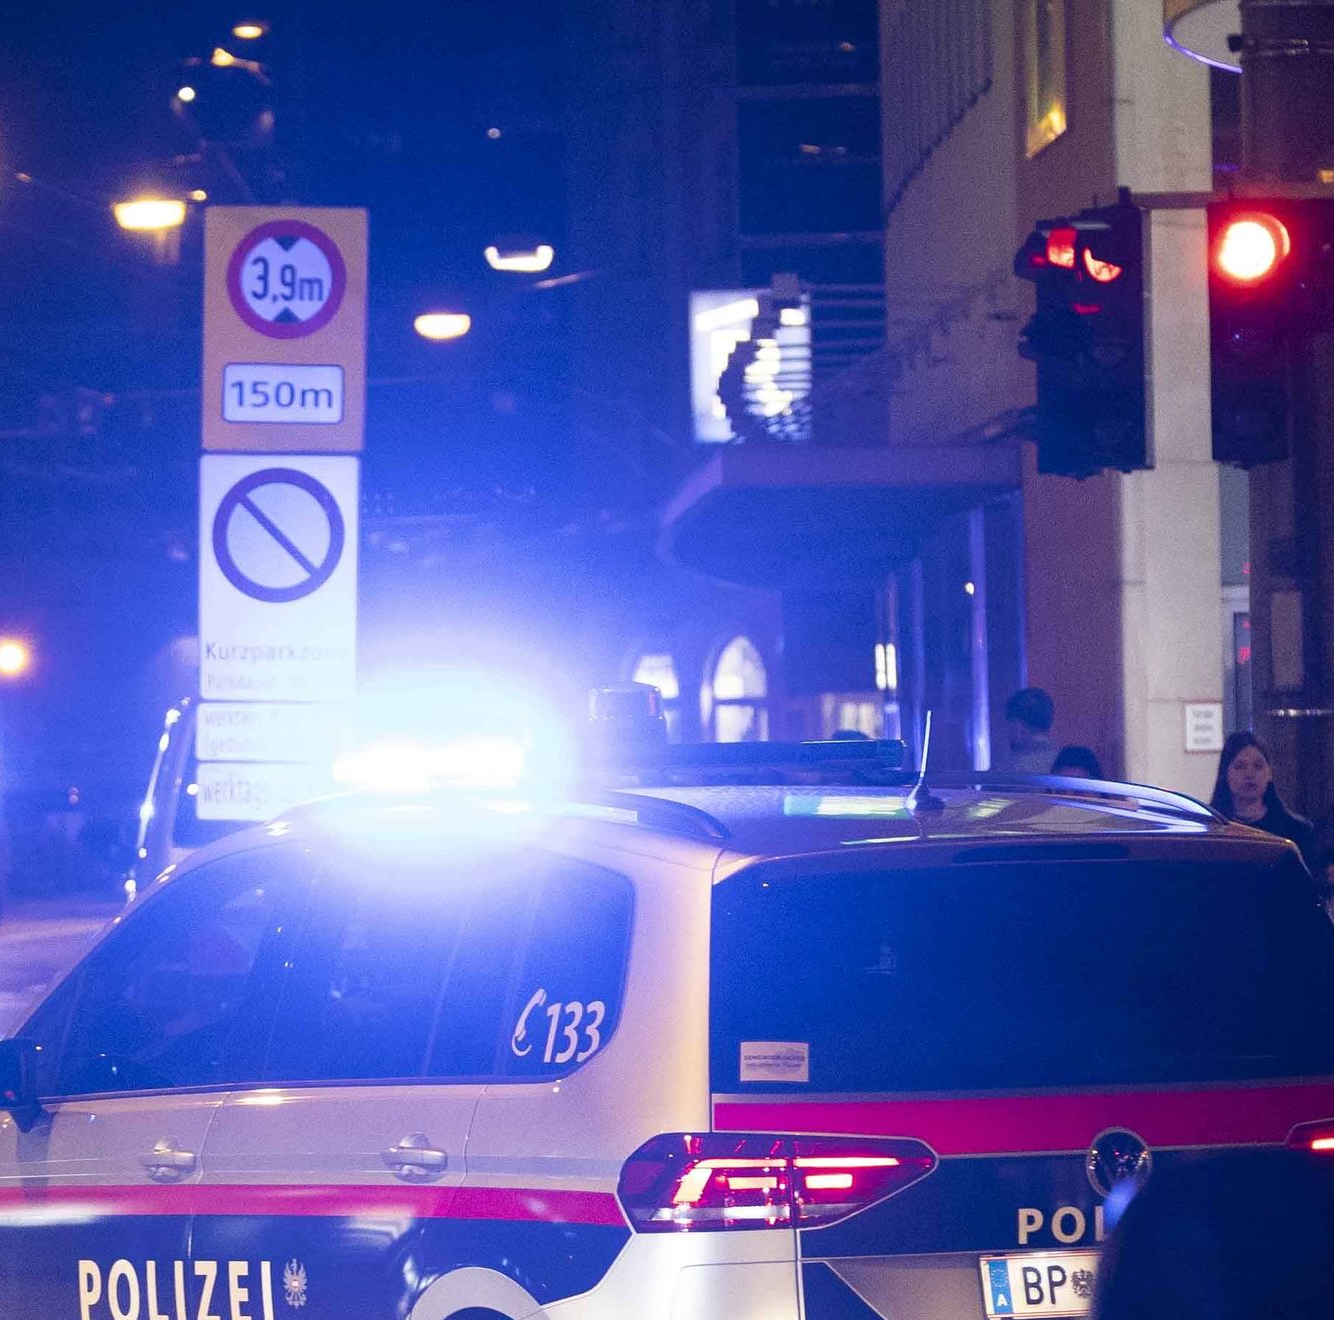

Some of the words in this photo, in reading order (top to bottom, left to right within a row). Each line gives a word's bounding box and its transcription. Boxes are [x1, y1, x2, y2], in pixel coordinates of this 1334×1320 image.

[251, 256, 323, 302] 3,9m
[231, 381, 333, 408] 150m
[543, 1000, 605, 1063] 133
[1018, 1205, 1110, 1244] POL
[997, 1293, 1008, 1306] A
[1022, 1265, 1067, 1305] BP
